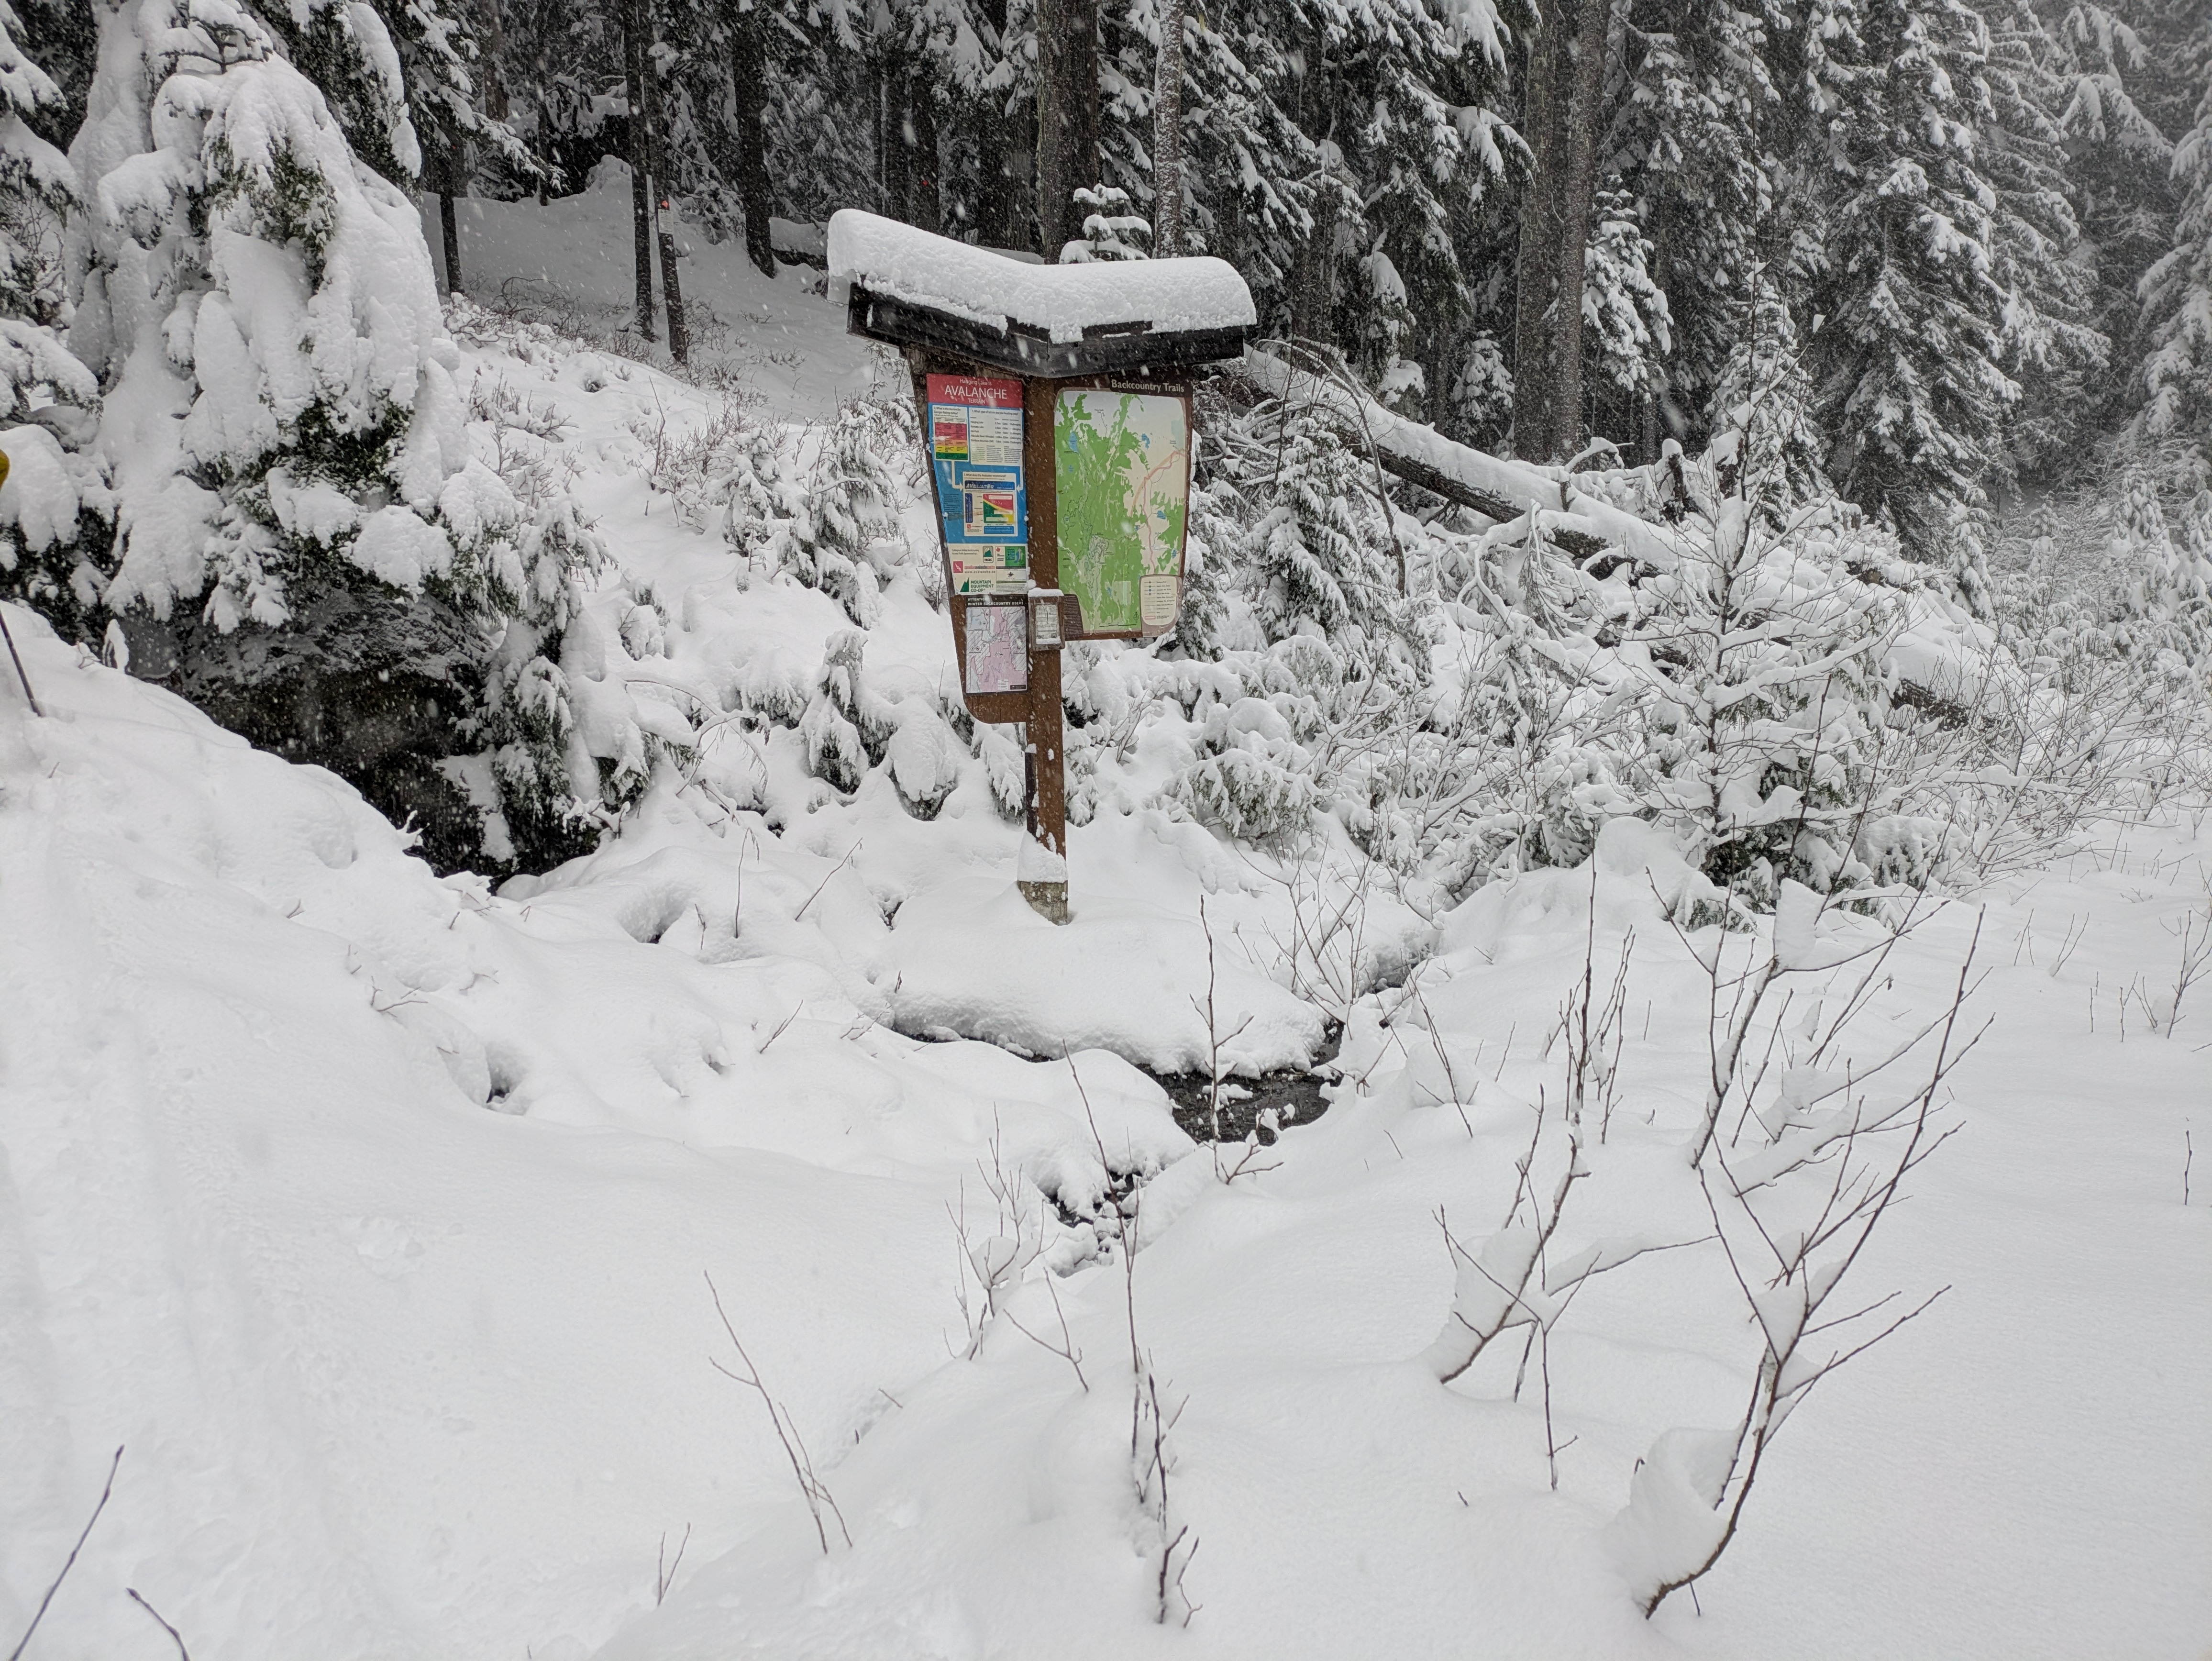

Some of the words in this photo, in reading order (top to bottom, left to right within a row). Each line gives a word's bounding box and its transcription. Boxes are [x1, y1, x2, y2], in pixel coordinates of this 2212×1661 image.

[944, 385, 1007, 399] AVALANCHE
[1111, 379, 1161, 393] Backcountry
[1163, 383, 1184, 392] Trails
